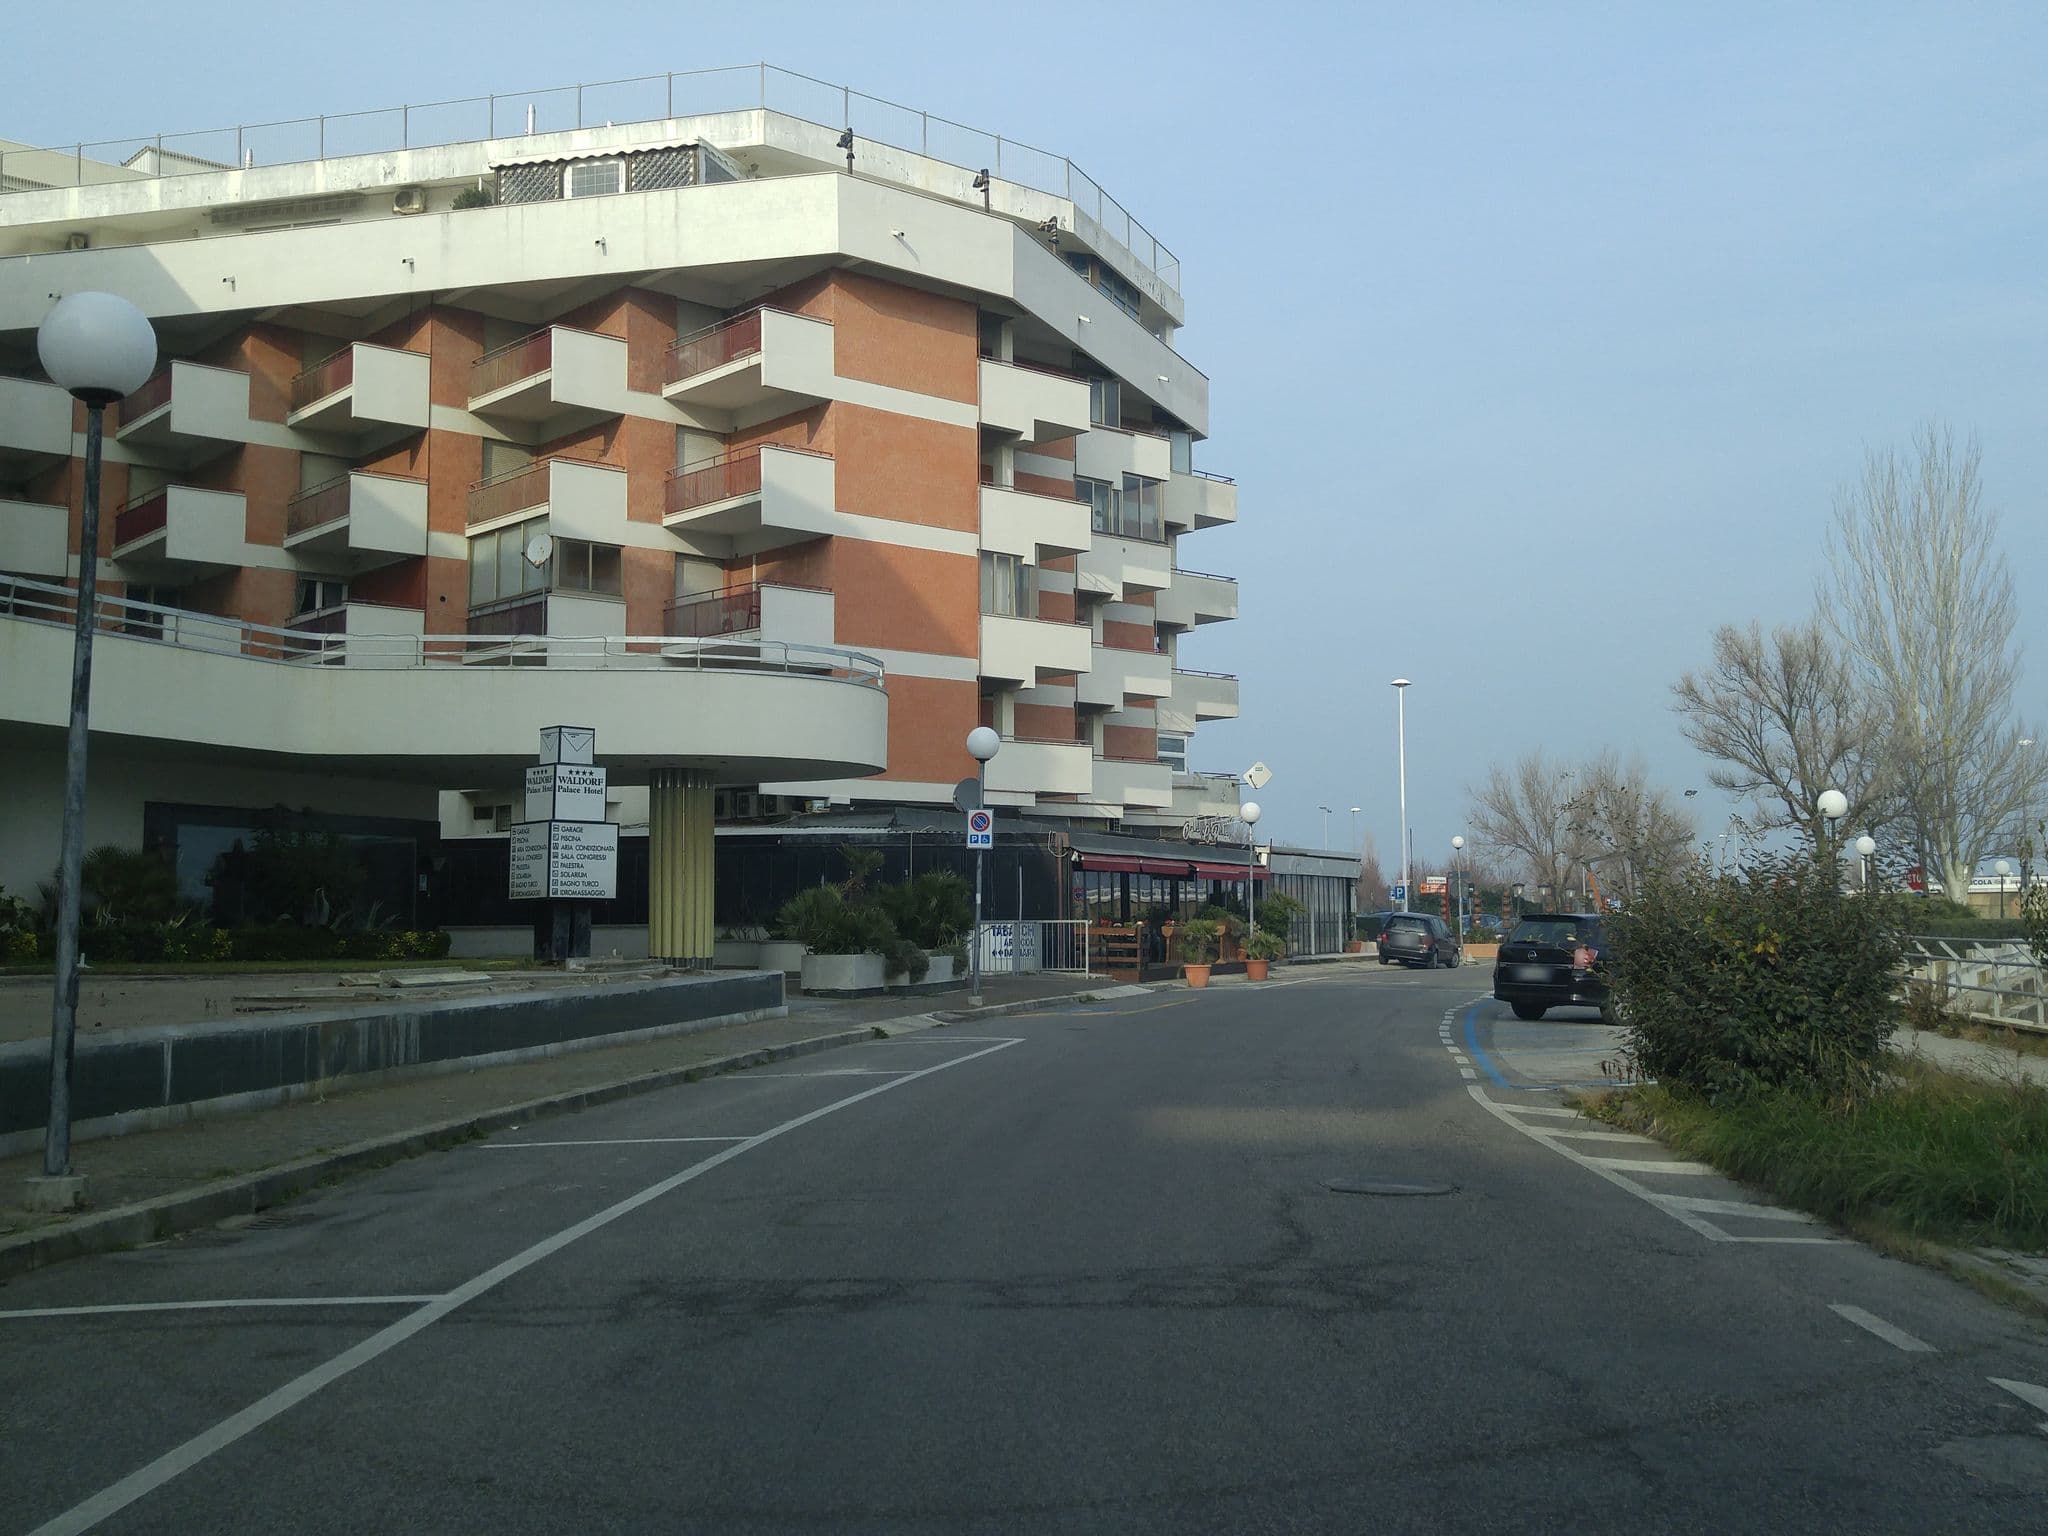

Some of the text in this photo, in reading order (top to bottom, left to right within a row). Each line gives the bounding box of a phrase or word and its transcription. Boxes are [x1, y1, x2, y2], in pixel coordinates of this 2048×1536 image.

[558, 775, 603, 786] WALDORF
[558, 785, 603, 795] Palace Hotel
[971, 835, 978, 843] P
[1907, 873, 1921, 883] STO
